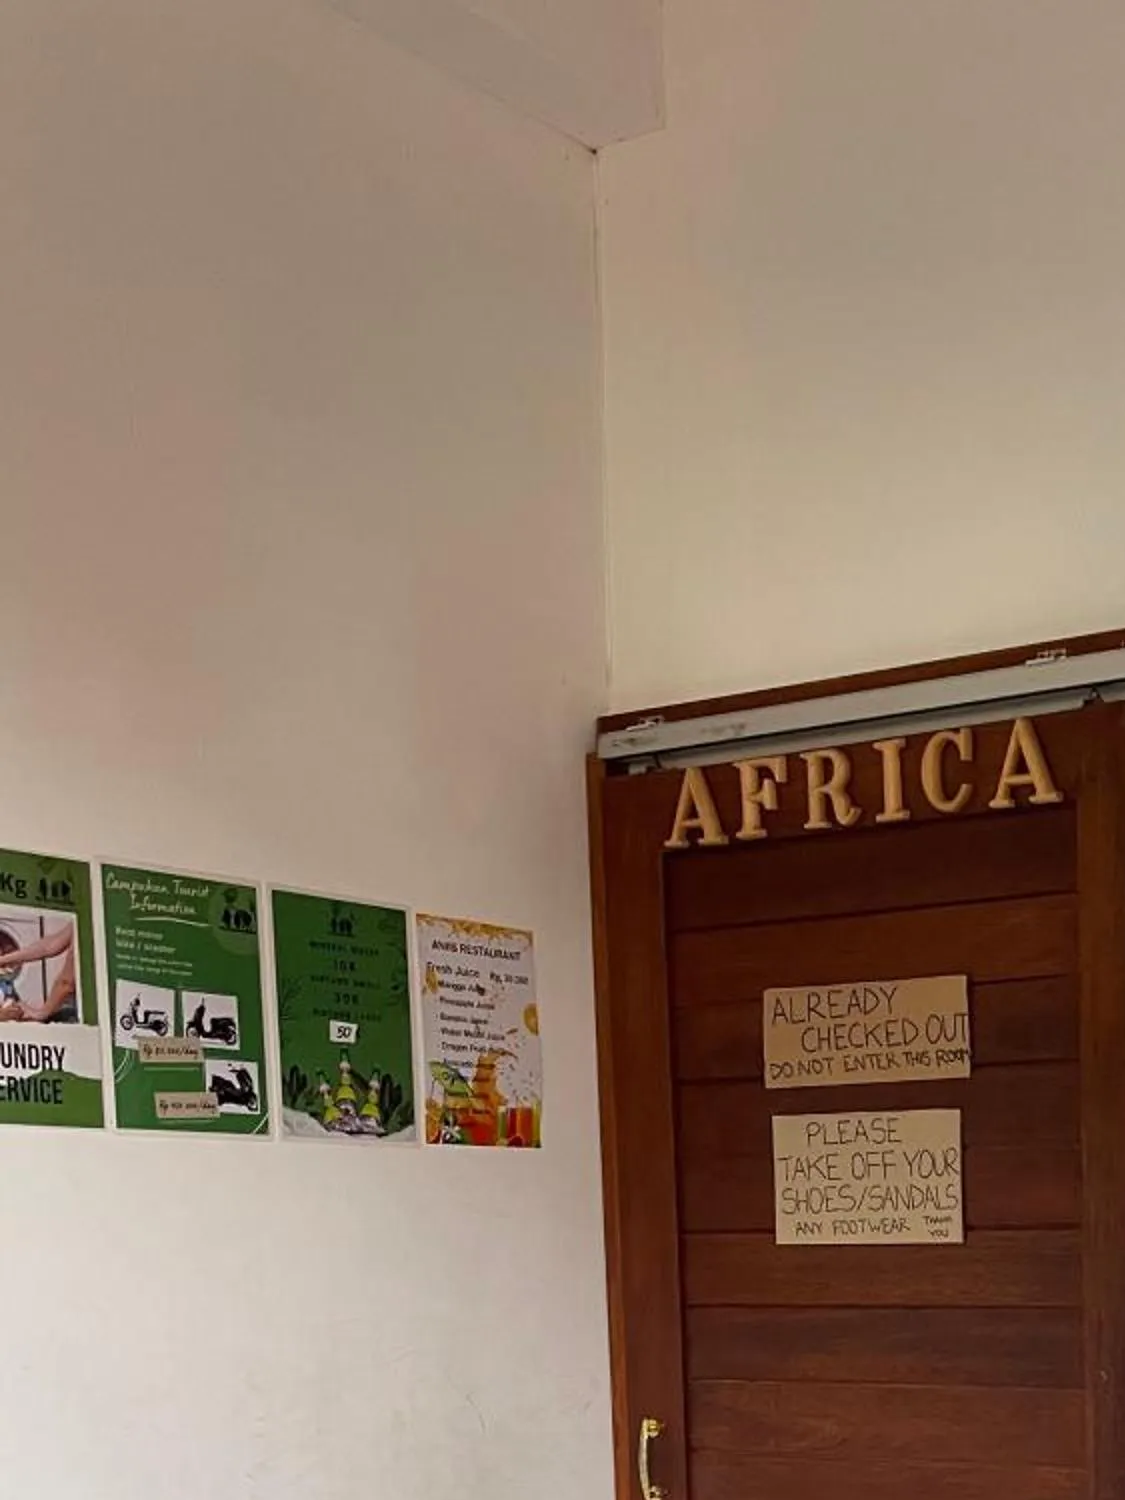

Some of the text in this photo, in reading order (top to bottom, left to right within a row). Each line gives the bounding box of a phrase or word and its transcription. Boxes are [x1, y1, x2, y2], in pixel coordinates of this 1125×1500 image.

[664, 717, 1063, 847] AFRICA
[129, 893, 198, 914] Information
[460, 943, 521, 960] RESTAURANT
[426, 961, 452, 975] Fresh
[455, 966, 480, 977] Juice
[772, 987, 897, 1025] ALREADY
[801, 1013, 968, 1053] CHECKED OUT
[769, 1062, 794, 1080] DO
[797, 1057, 834, 1076] NOT
[843, 1051, 901, 1072] ENTER
[901, 1050, 931, 1067] THIS
[806, 1117, 902, 1146] PLEASE
[776, 1146, 960, 1181] TAKE OFF YOUR
[782, 1183, 959, 1215] SHOES/SANDALS
[795, 1217, 911, 1237] ANY FOOTWEAR
